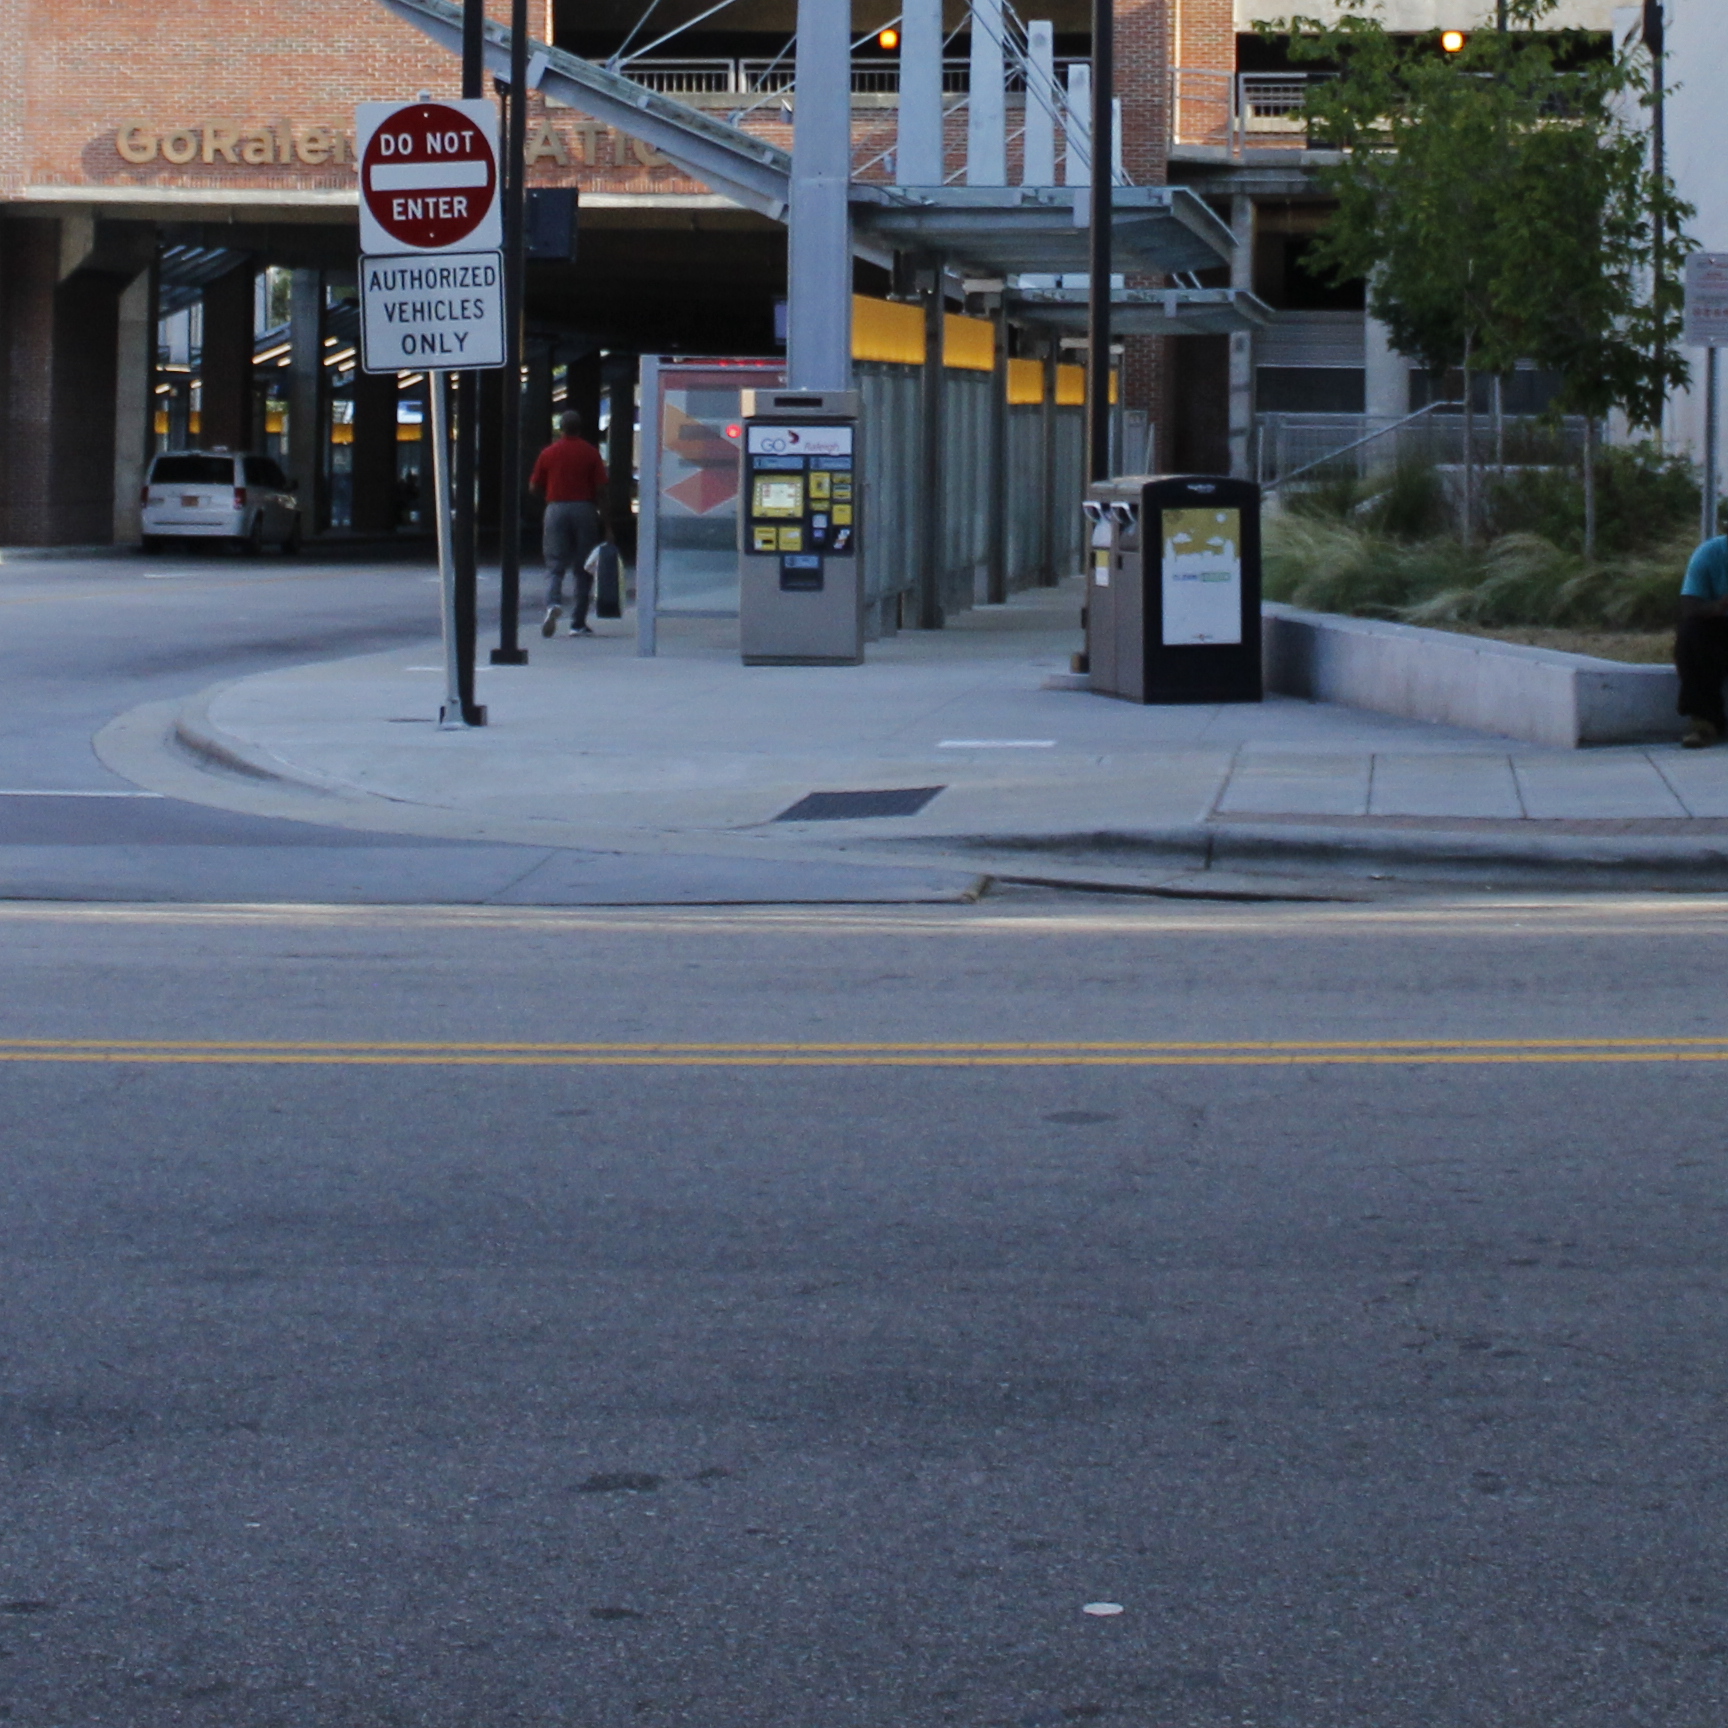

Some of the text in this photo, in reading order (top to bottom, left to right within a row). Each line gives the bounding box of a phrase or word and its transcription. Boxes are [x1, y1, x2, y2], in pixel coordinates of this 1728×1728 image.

[380, 131, 474, 155] DO NOT
[392, 197, 468, 221] ENTER
[369, 266, 495, 292] AUTHORIZED
[384, 299, 484, 323] VEHICLES
[402, 331, 469, 355] ONLY
[761, 437, 786, 452] GO
